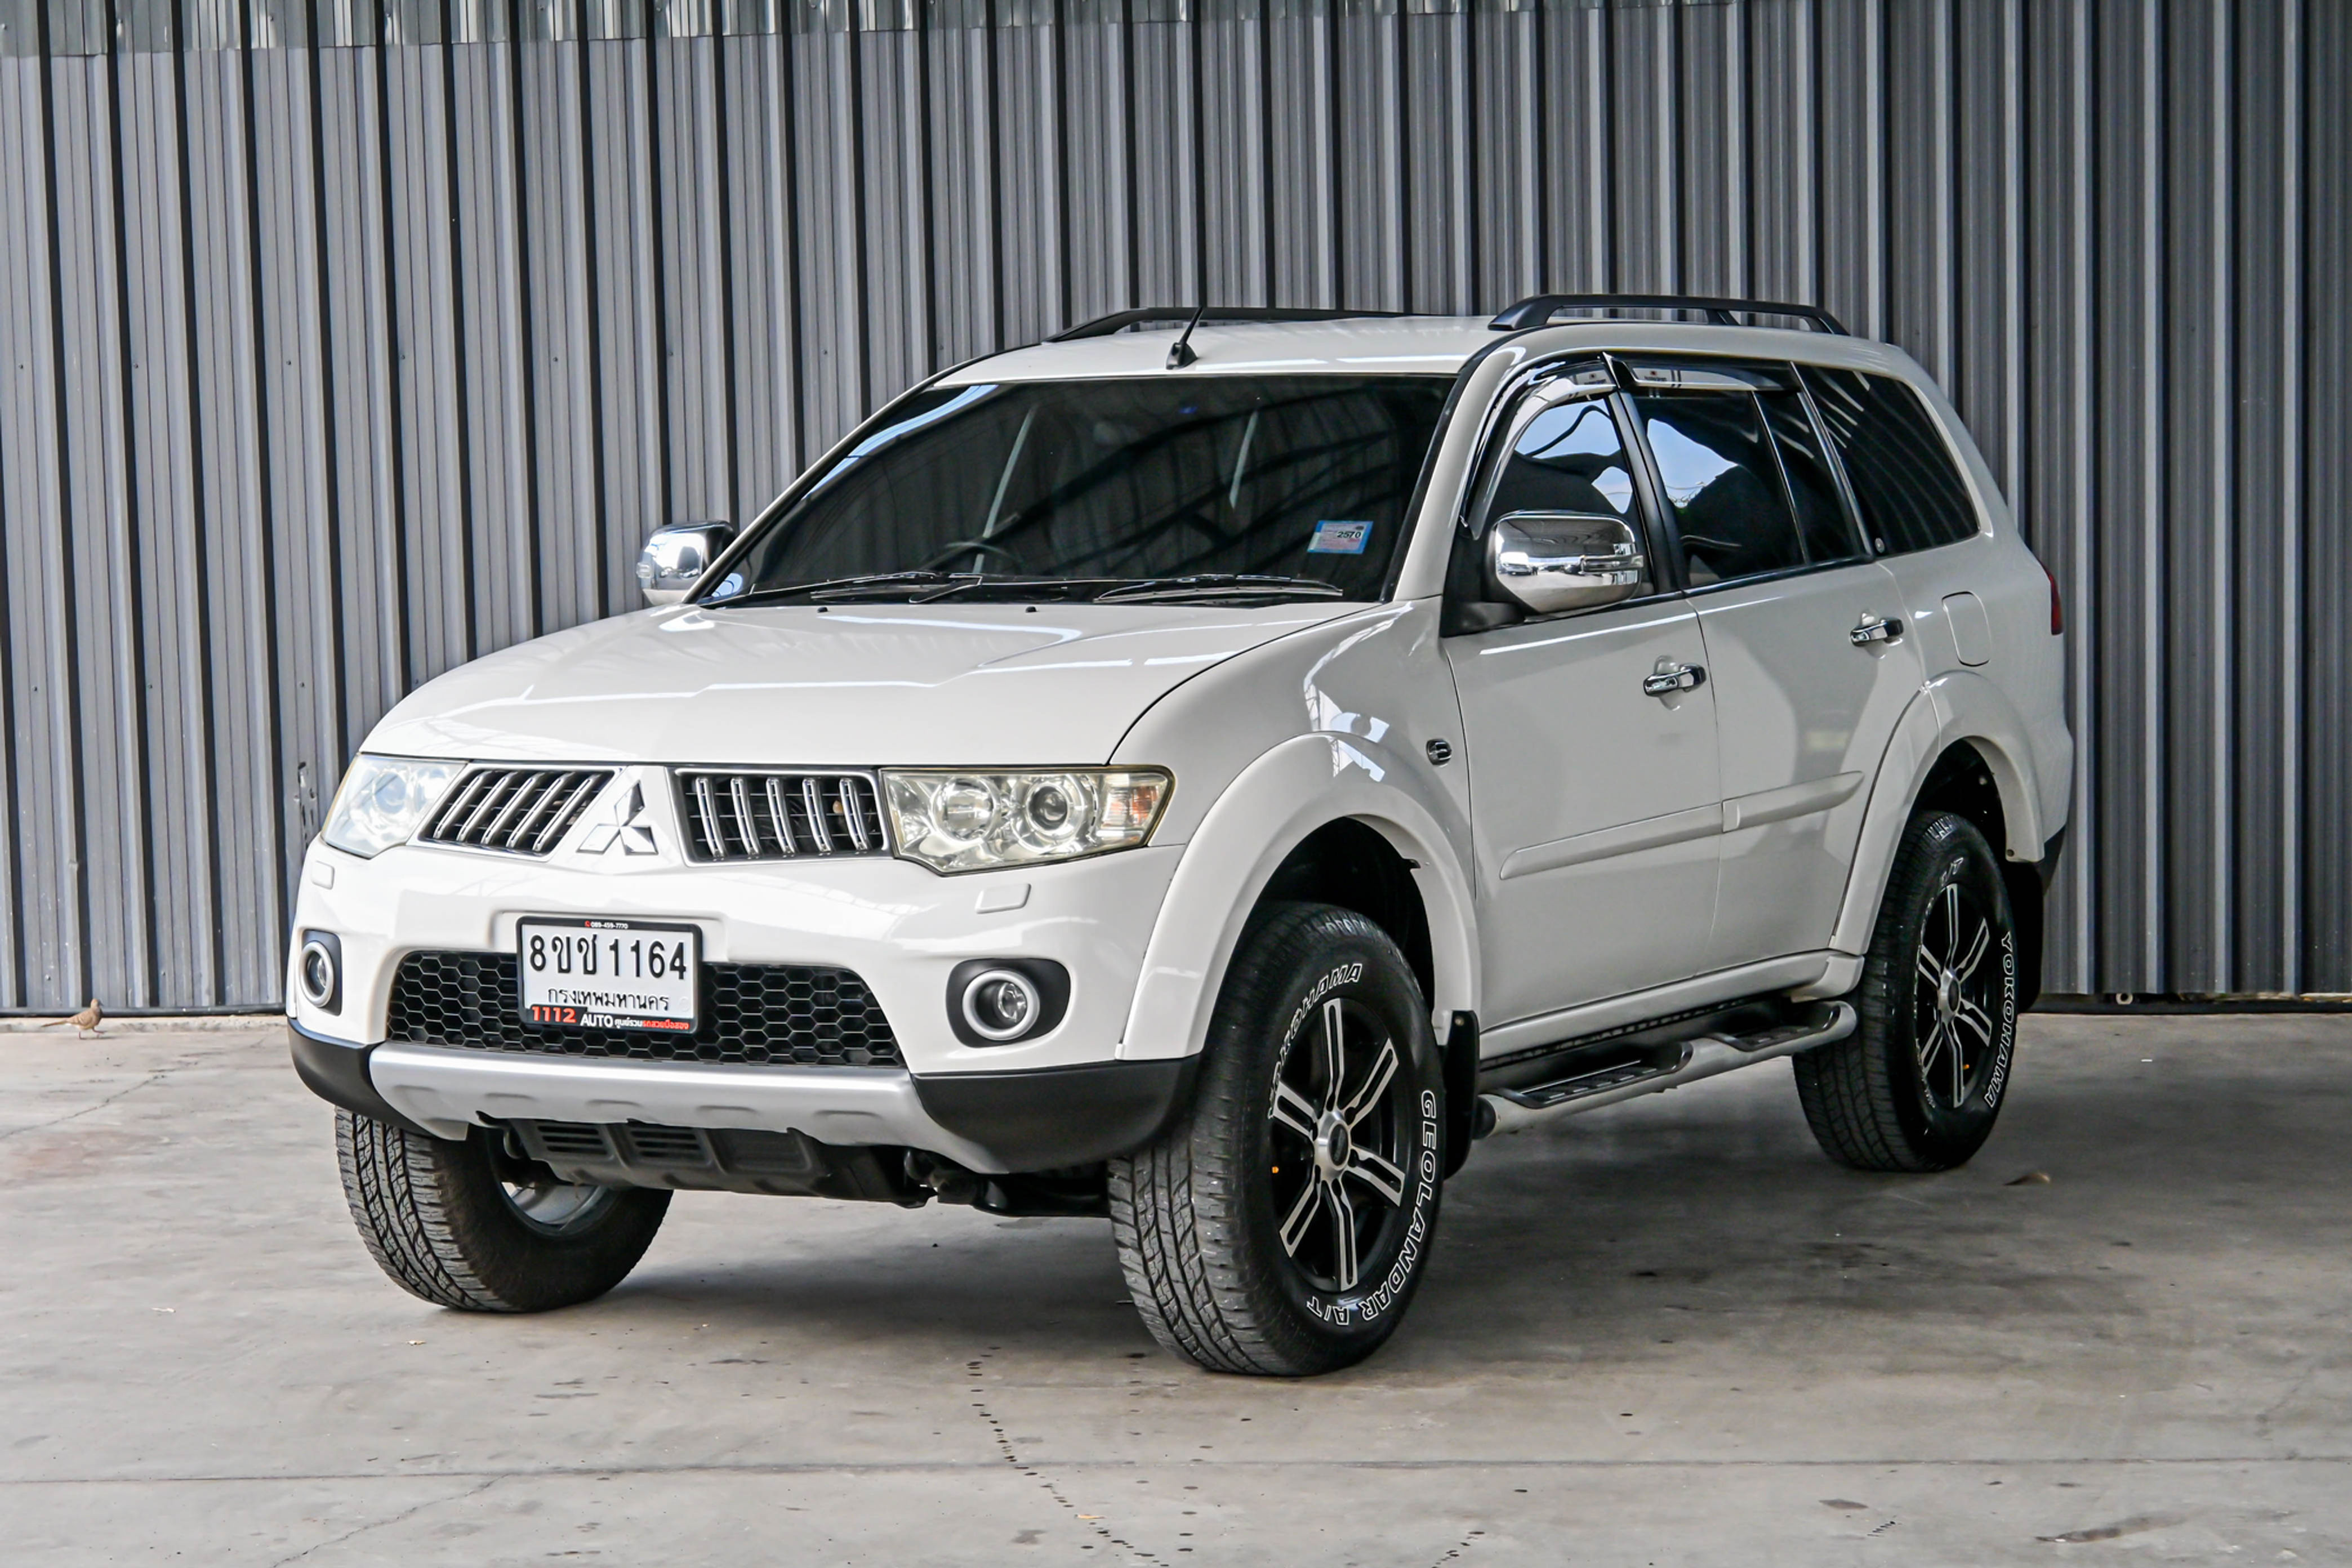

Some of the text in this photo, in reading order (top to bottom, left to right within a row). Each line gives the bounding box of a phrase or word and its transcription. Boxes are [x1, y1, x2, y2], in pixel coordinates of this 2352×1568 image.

[1337, 531, 1362, 539] 2570
[609, 938, 687, 980] 1164
[547, 988, 669, 1011] กรงเทพมหานคร
[531, 1005, 577, 1023] 1112
[580, 1013, 614, 1028] AUTO
[1984, 930, 2014, 1108] YOKOHAMA
[1306, 1089, 1437, 1326] GEOLANDAR A/T
